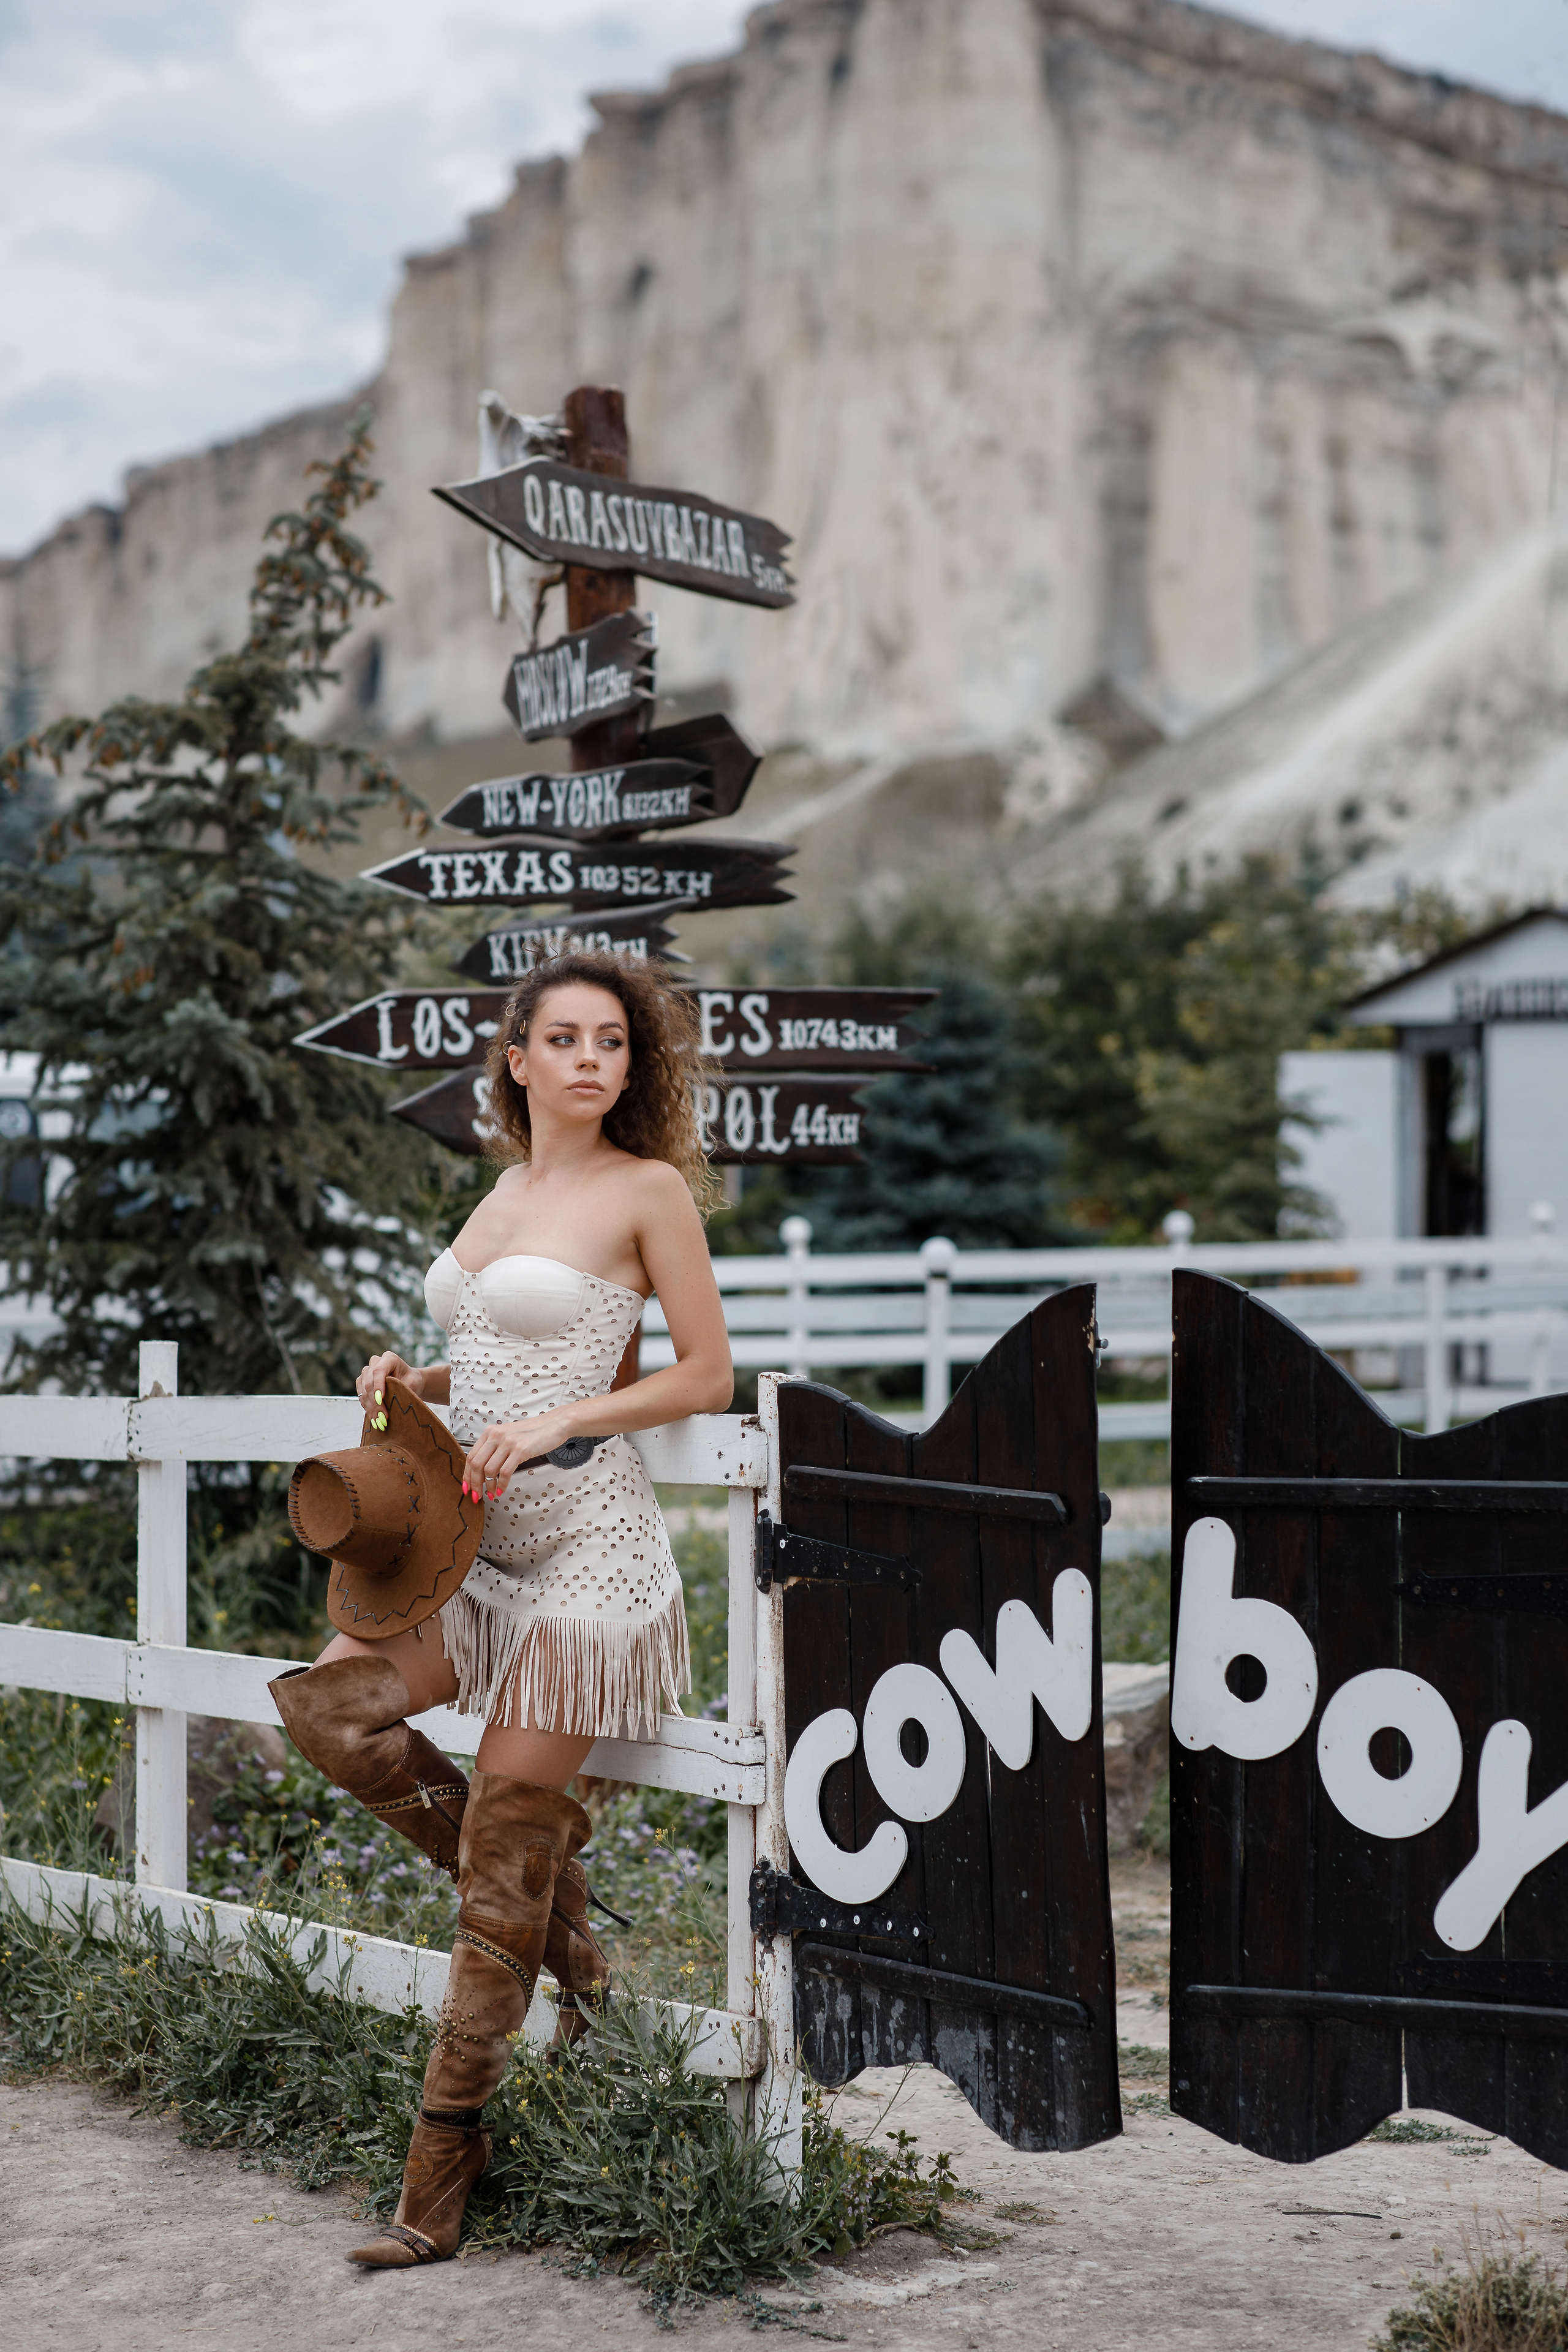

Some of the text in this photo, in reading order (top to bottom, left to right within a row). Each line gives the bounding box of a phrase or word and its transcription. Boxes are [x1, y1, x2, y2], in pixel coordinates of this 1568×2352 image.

[482, 769, 625, 828] NEW-YORK
[418, 850, 575, 899] TEXAS
[777, 1018, 899, 1052] 10743KM
